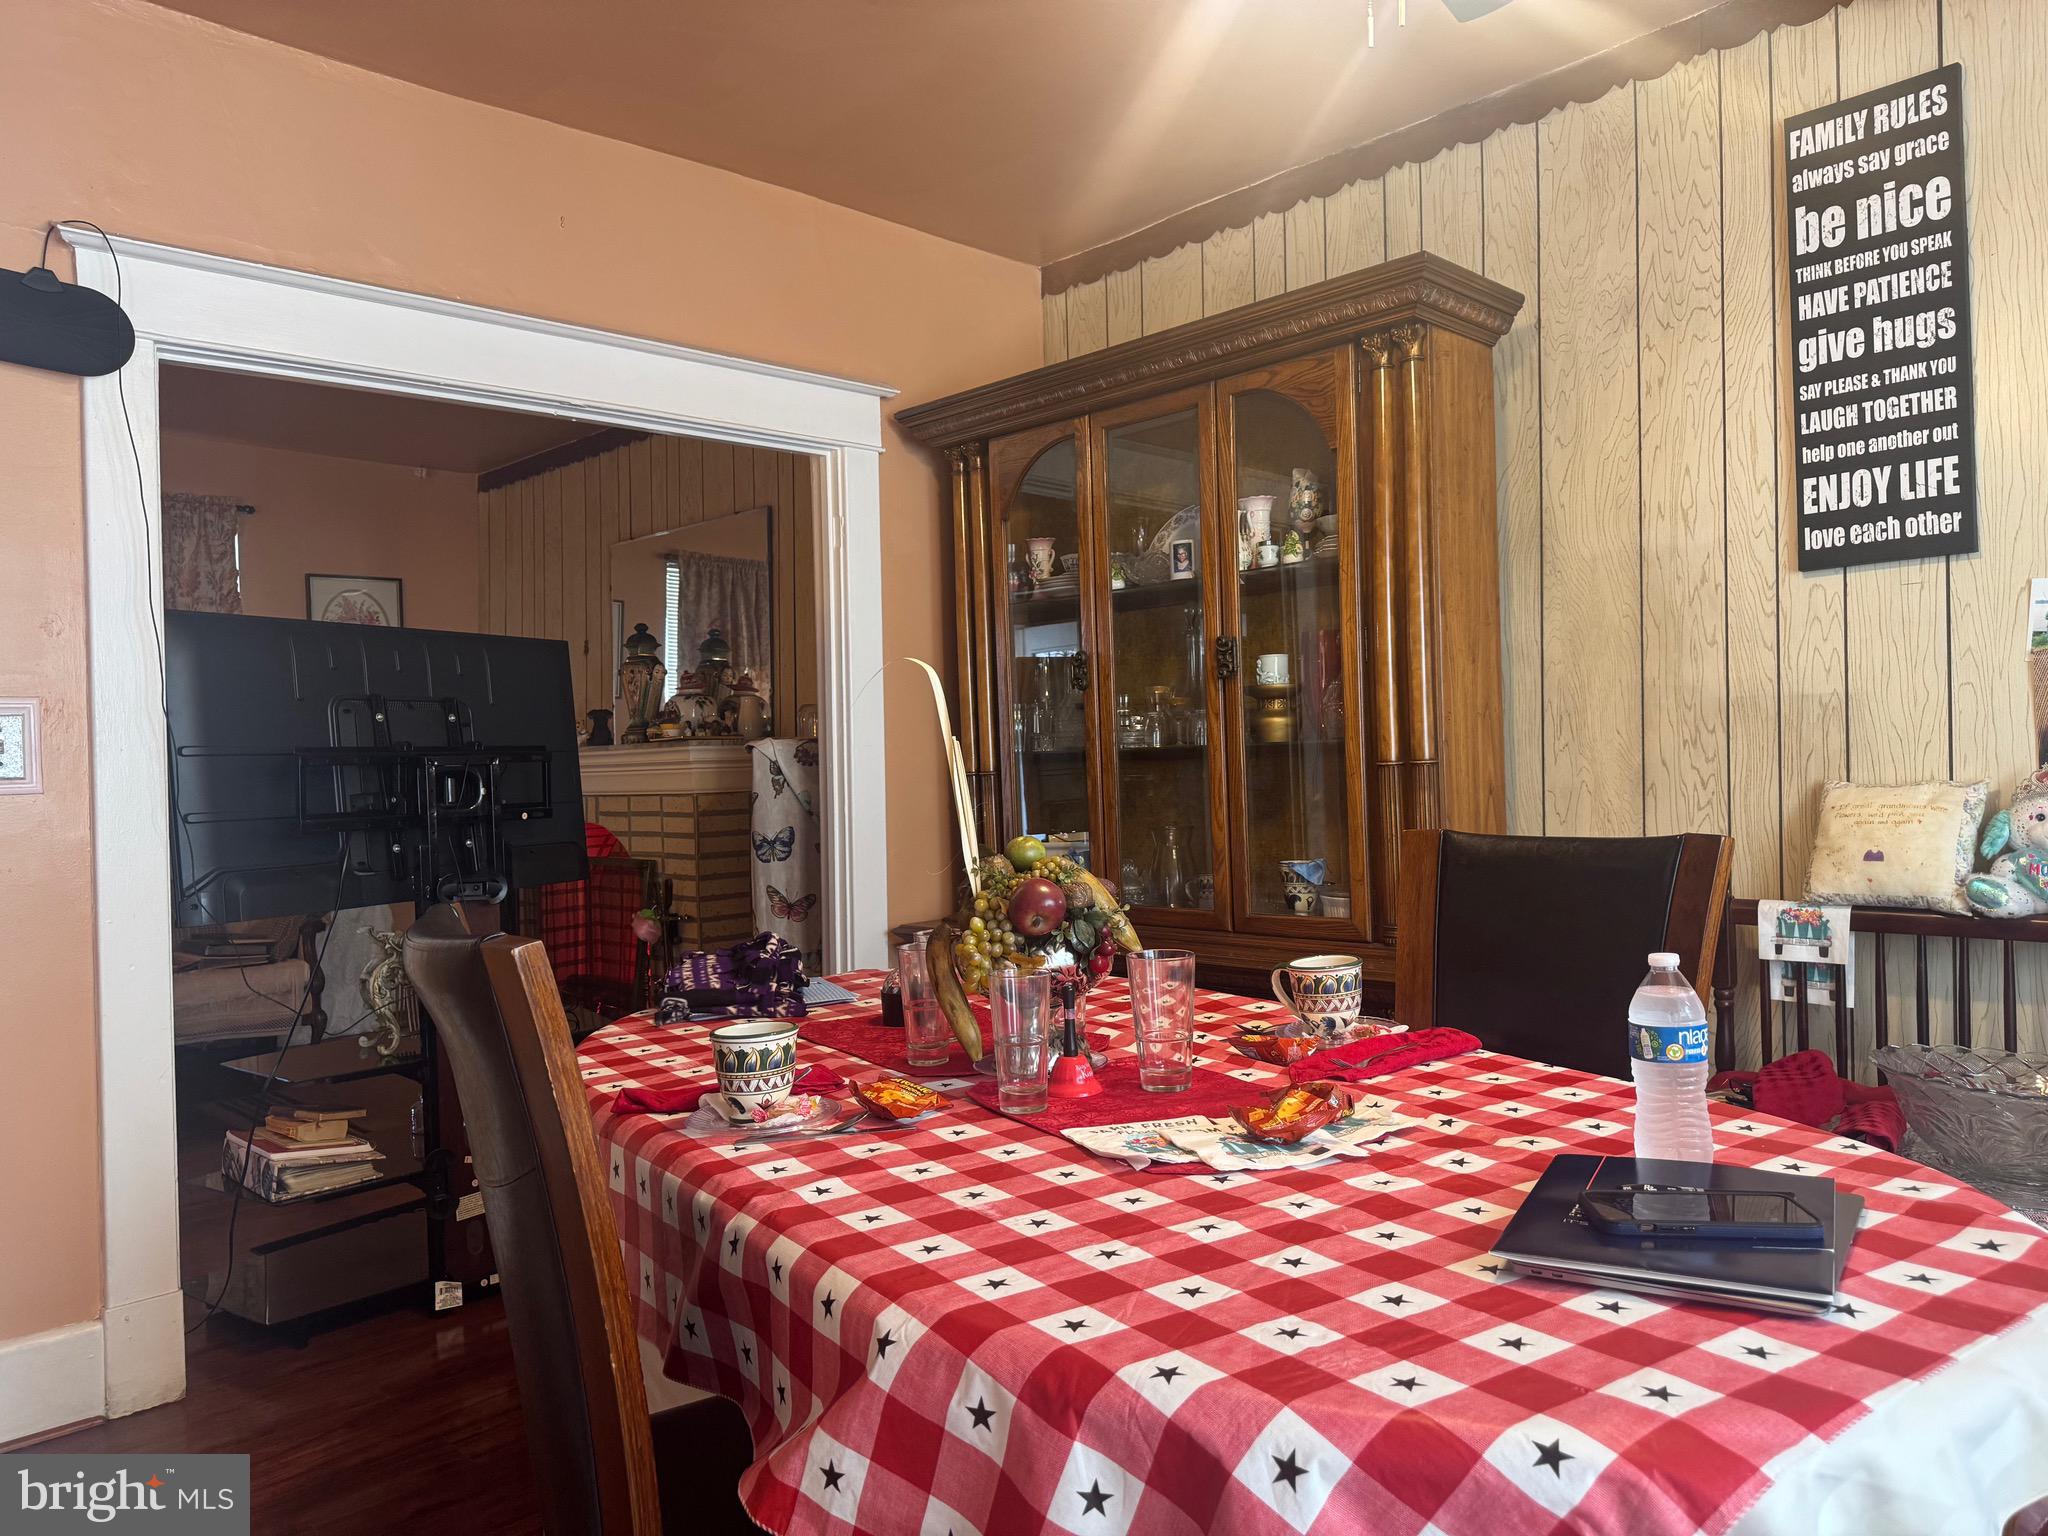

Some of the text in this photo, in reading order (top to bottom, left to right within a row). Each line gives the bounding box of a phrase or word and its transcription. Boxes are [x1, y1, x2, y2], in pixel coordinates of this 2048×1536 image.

[1790, 83, 1948, 160] FAMILY RULES
[1792, 130, 1950, 194] always say grace
[1795, 175, 1952, 256] be nice
[1795, 230, 1952, 284] THINK BEFORE YOU SPEAK
[1798, 260, 1952, 321] HAVE PATIENCE
[1798, 306, 1956, 373] give hugs
[1799, 356, 1957, 402] SAY PLEASE & THANK YOU
[1801, 386, 1958, 435] LAUGH TOGETHER
[1802, 422, 1959, 464] help one another out
[1803, 455, 1961, 515] ENJOY LIFE
[1804, 510, 1962, 551] love each other
